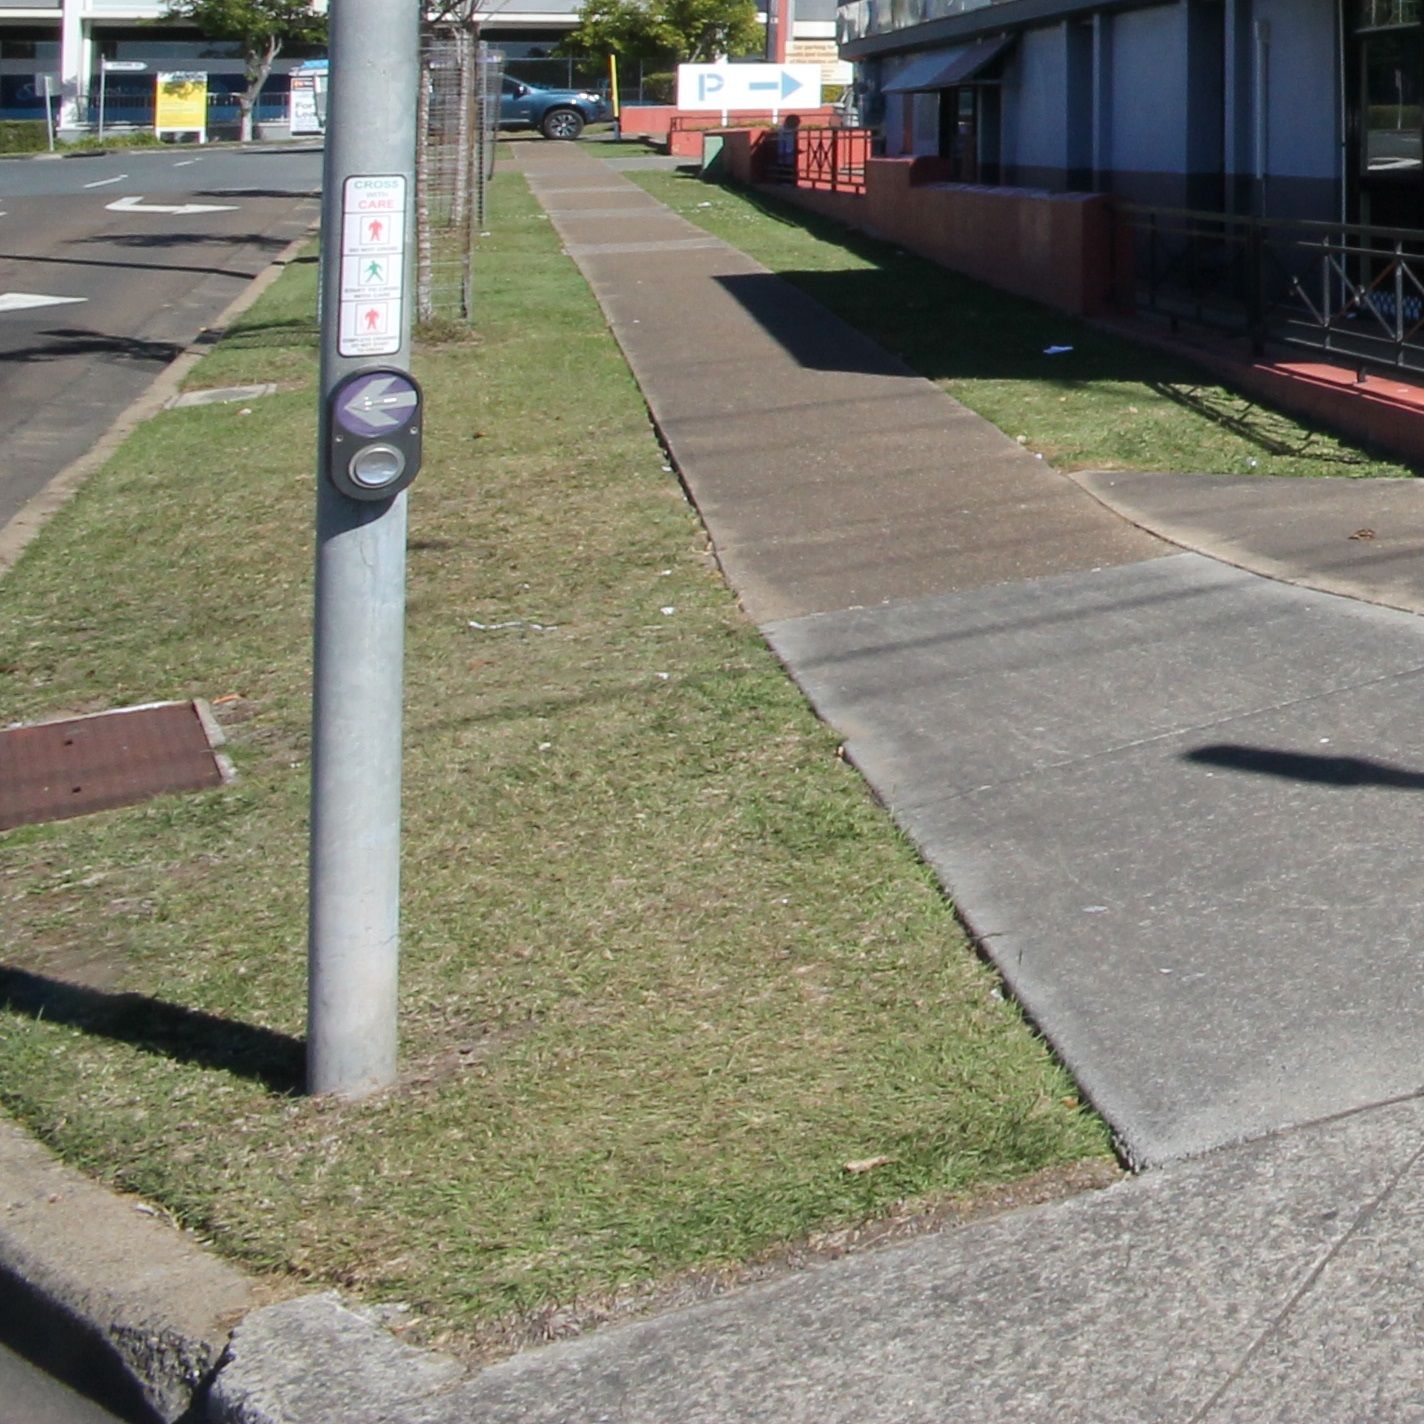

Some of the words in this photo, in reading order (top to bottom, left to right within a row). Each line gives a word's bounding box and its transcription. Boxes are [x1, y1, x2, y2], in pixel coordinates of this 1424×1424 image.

[354, 179, 400, 190] CROSS
[366, 191, 389, 199] WITH
[358, 199, 394, 210] CARE
